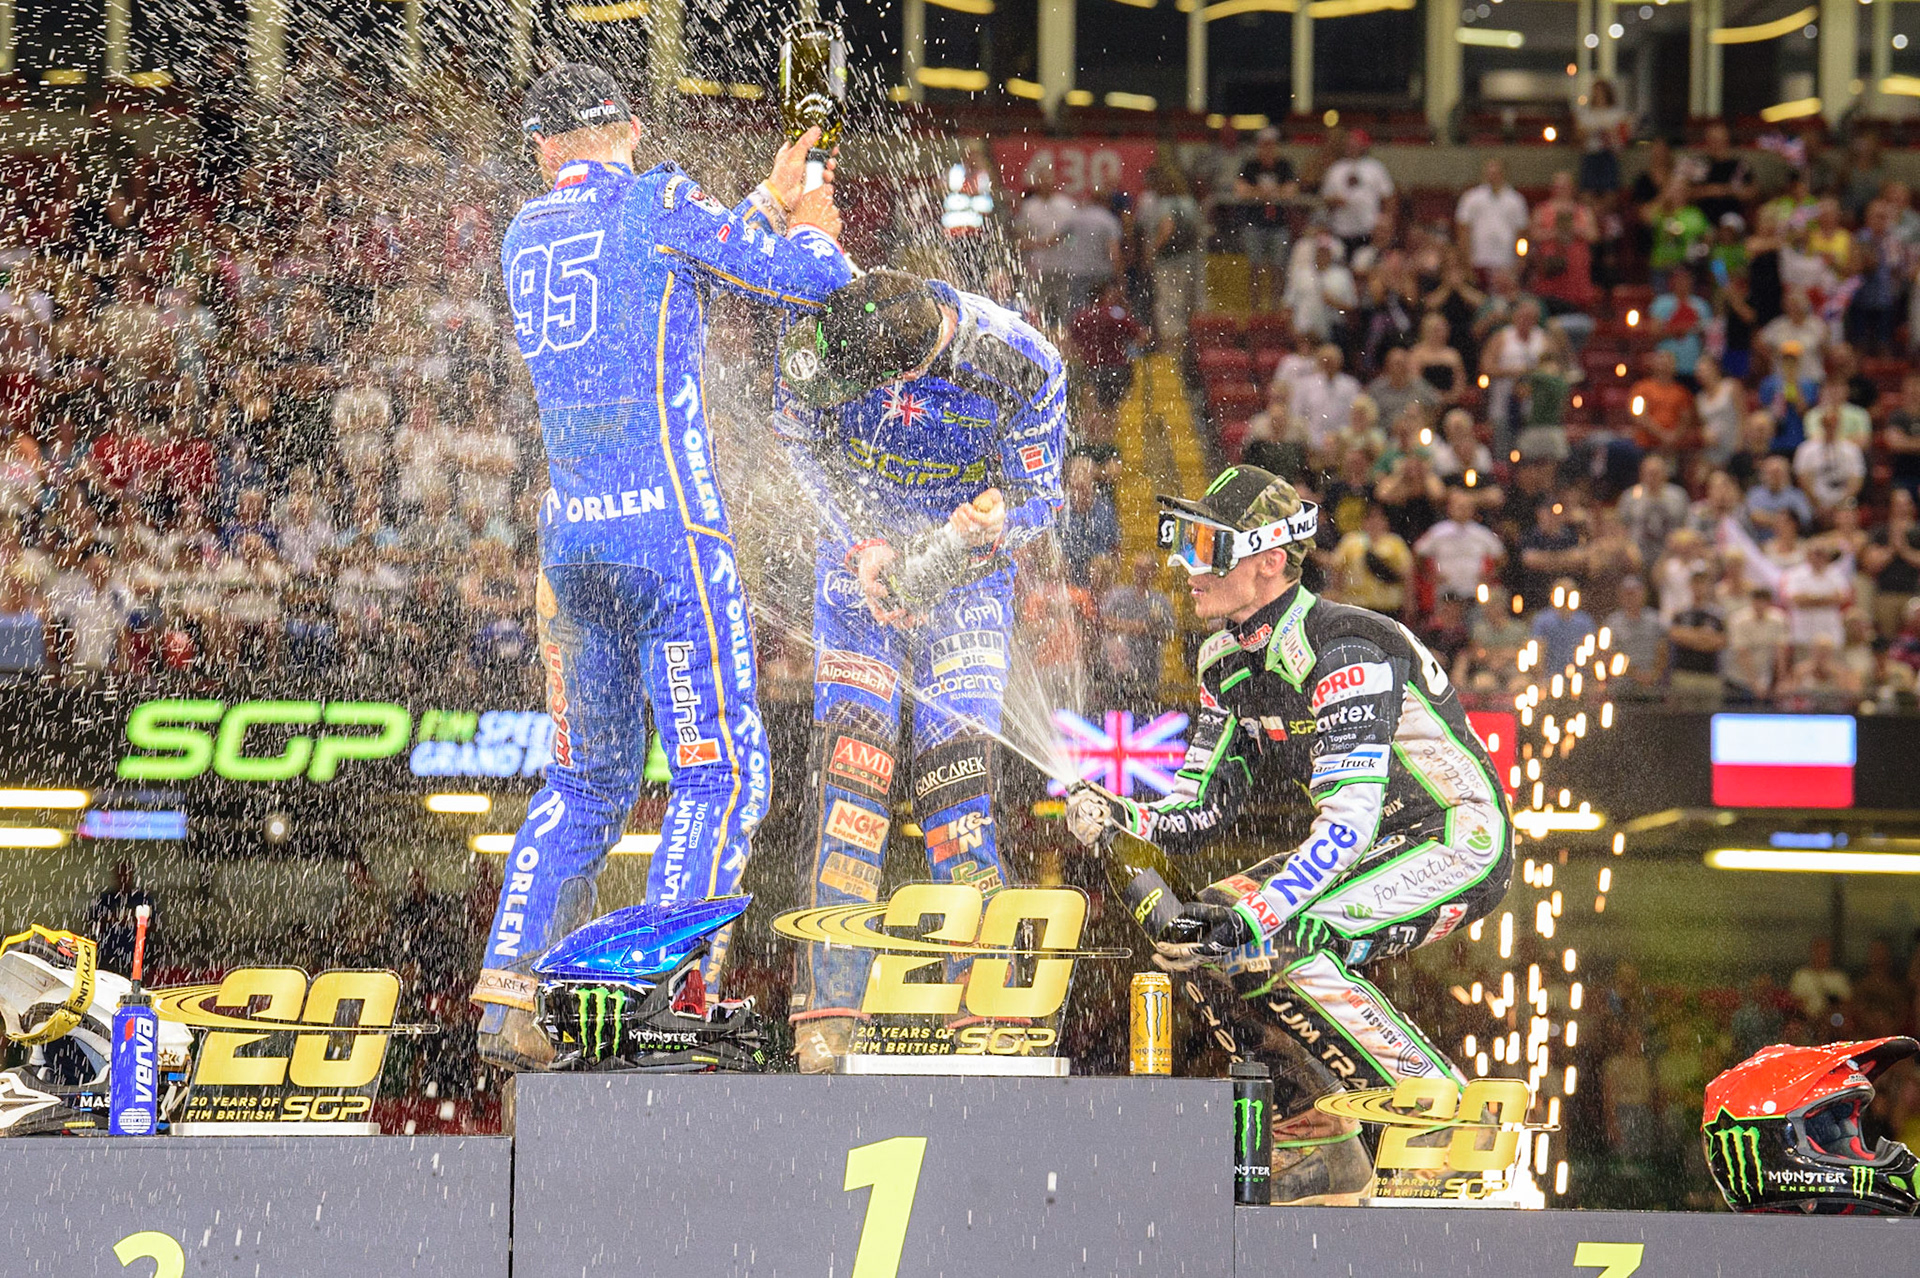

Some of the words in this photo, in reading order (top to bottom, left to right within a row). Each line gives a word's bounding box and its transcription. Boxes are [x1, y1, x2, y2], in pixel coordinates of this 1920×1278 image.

[580, 104, 618, 119] verva
[1023, 150, 1122, 196] 430
[510, 230, 605, 359] 95
[683, 428, 720, 522] ORLEN
[847, 437, 960, 485] SGP
[566, 486, 666, 523] ORLEN
[726, 599, 752, 691] ORLEN
[821, 664, 886, 692] Alpodach
[921, 674, 1004, 701] colorama
[1313, 666, 1366, 708] PRO
[118, 701, 412, 781] SGP
[1329, 732, 1357, 742] Toyota
[836, 742, 893, 777] AMD
[834, 763, 887, 788] GROUP
[915, 756, 987, 796] GARCAREK
[741, 751, 765, 835] ORLEN
[694, 801, 709, 821] OIL
[1382, 797, 1405, 818] RIX
[689, 822, 702, 849] ORLEN
[835, 806, 885, 841] NGK
[1271, 822, 1358, 906] Nice
[495, 846, 539, 957] ORLEN
[1135, 887, 1164, 924] SGP
[1373, 883, 1400, 909] for
[861, 884, 1087, 1017] 20
[73, 980, 90, 1008] LINE
[195, 968, 400, 1087] 20
[629, 1029, 699, 1045] MONSTER
[857, 1027, 875, 1038] 20
[881, 1027, 931, 1038] YEARS
[935, 1028, 956, 1038] OF
[956, 1027, 1057, 1055] SGP
[135, 1016, 154, 1103] verva
[639, 1043, 689, 1051] ENERGY
[853, 1042, 880, 1053] FIM
[886, 1042, 951, 1054] BRITISH
[186, 1110, 212, 1120] FIM
[216, 1110, 276, 1121] BRITISH
[190, 1096, 209, 1107] 20
[212, 1096, 258, 1107] YEARS
[261, 1096, 281, 1107] OF
[280, 1096, 372, 1121] SGP
[1377, 1078, 1530, 1171] 20
[1234, 1164, 1271, 1177] NSTER
[1388, 1178, 1426, 1187] YEARS
[1428, 1178, 1442, 1187] OF
[1768, 1169, 1848, 1185] MONSTER
[1394, 1188, 1439, 1197] BRITISH
[1443, 1178, 1509, 1199] SGP
[1780, 1185, 1836, 1193] ENERGY
